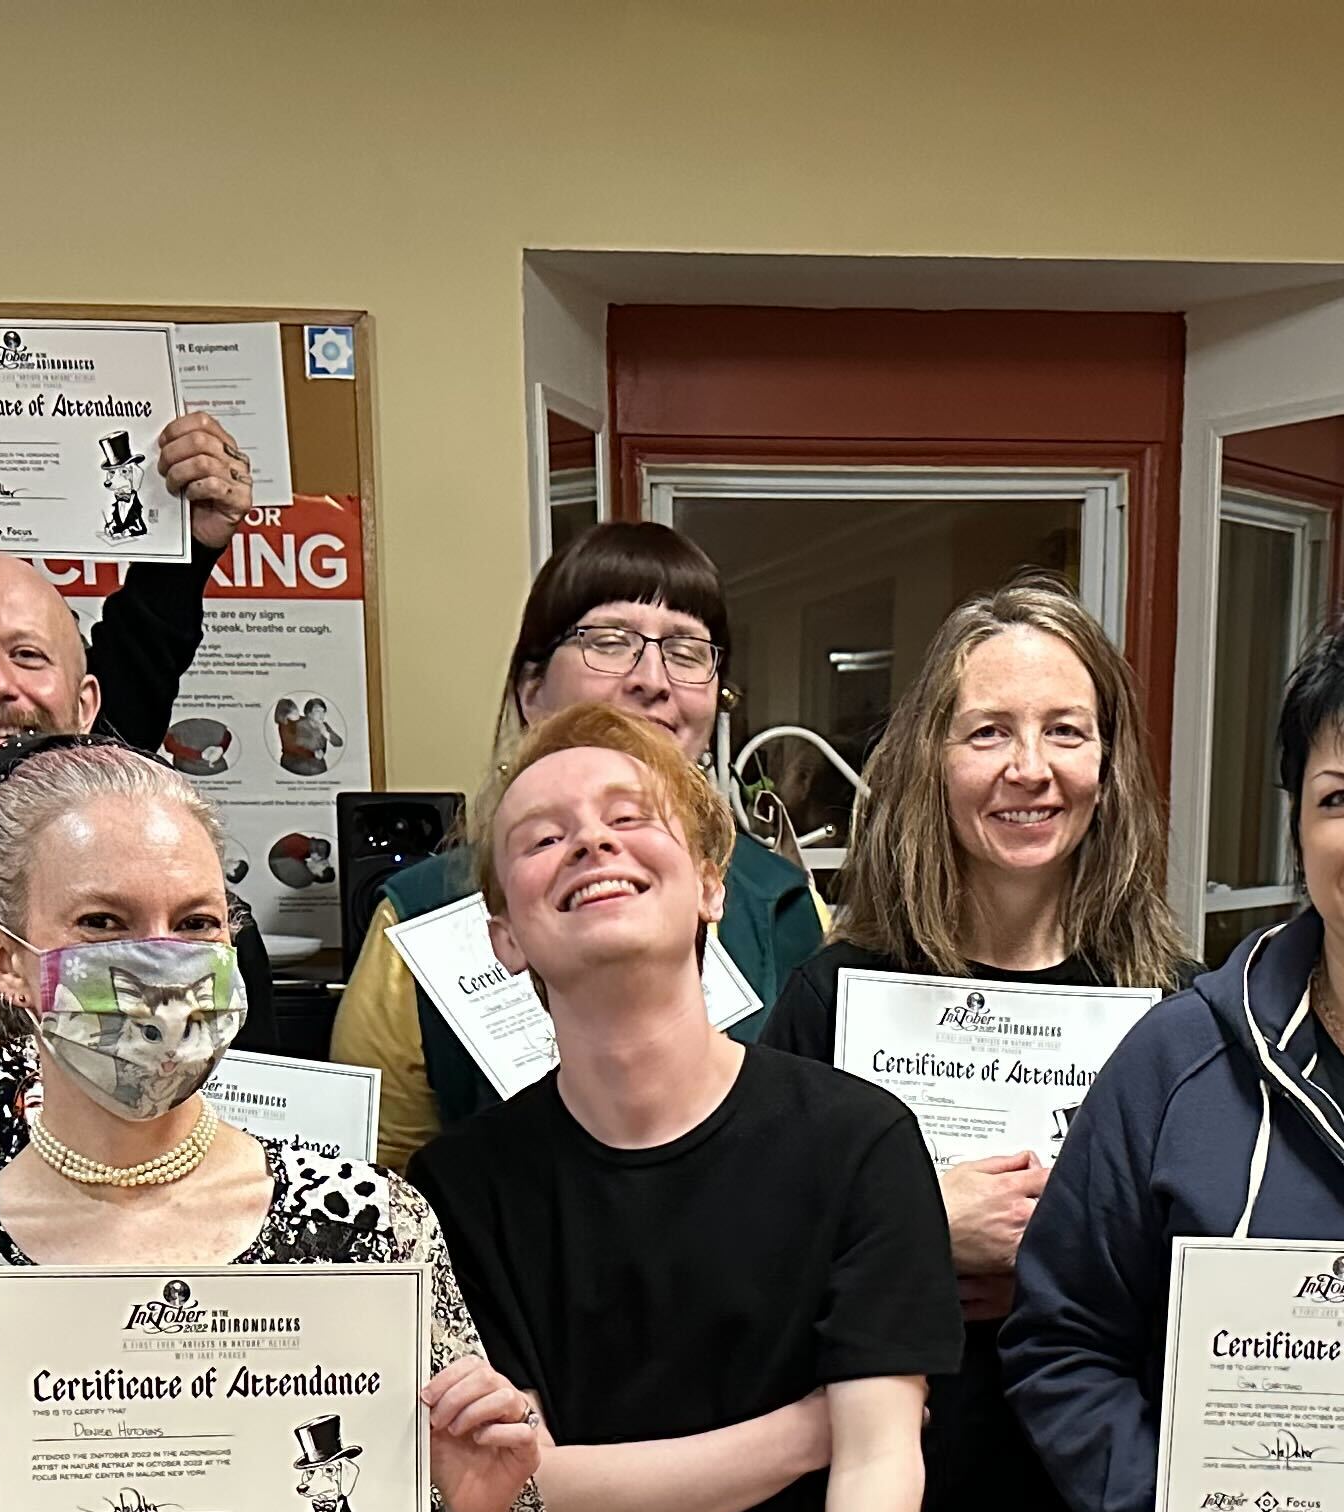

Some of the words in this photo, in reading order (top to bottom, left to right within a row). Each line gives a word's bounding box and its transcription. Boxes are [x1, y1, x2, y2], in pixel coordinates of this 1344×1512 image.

[188, 343, 239, 353] Equipment
[36, 359, 95, 370] ADIRONDACKS
[29, 393, 45, 417] of
[51, 394, 153, 419] Attendance
[244, 507, 282, 527] OR
[6, 526, 32, 536] Focus
[220, 611, 236, 619] are
[238, 611, 257, 621] any
[258, 610, 285, 621] signs
[211, 625, 244, 634] speak,
[246, 623, 284, 633] breathe
[286, 625, 297, 633] or
[299, 625, 333, 635] cough.
[458, 961, 507, 995] Certif
[997, 1024, 1062, 1038] ADIRONDACKS
[872, 1049, 975, 1081] Certificate
[981, 1053, 1000, 1082] of
[1005, 1059, 1098, 1087] Attendan
[224, 1090, 287, 1108] ADIRONDACKS
[123, 1300, 206, 1334] InkTober
[183, 1323, 208, 1333] 2022
[211, 1317, 300, 1333] ADIRONDACKS
[1212, 1329, 1341, 1362] Certificate
[33, 1368, 182, 1402] Certificate
[191, 1366, 217, 1399] of
[227, 1365, 381, 1401] Attendance
[74, 1408, 105, 1416] CERTIFY
[107, 1407, 127, 1415] THAT
[32, 1453, 71, 1461] ATTENDED
[32, 1463, 59, 1471] ARTIST
[70, 1462, 100, 1470] NATURE
[146, 1460, 181, 1468] OCTOBER
[216, 1458, 231, 1466] THE
[59, 1472, 93, 1480] RETREAT
[1286, 1496, 1321, 1508] Focus
